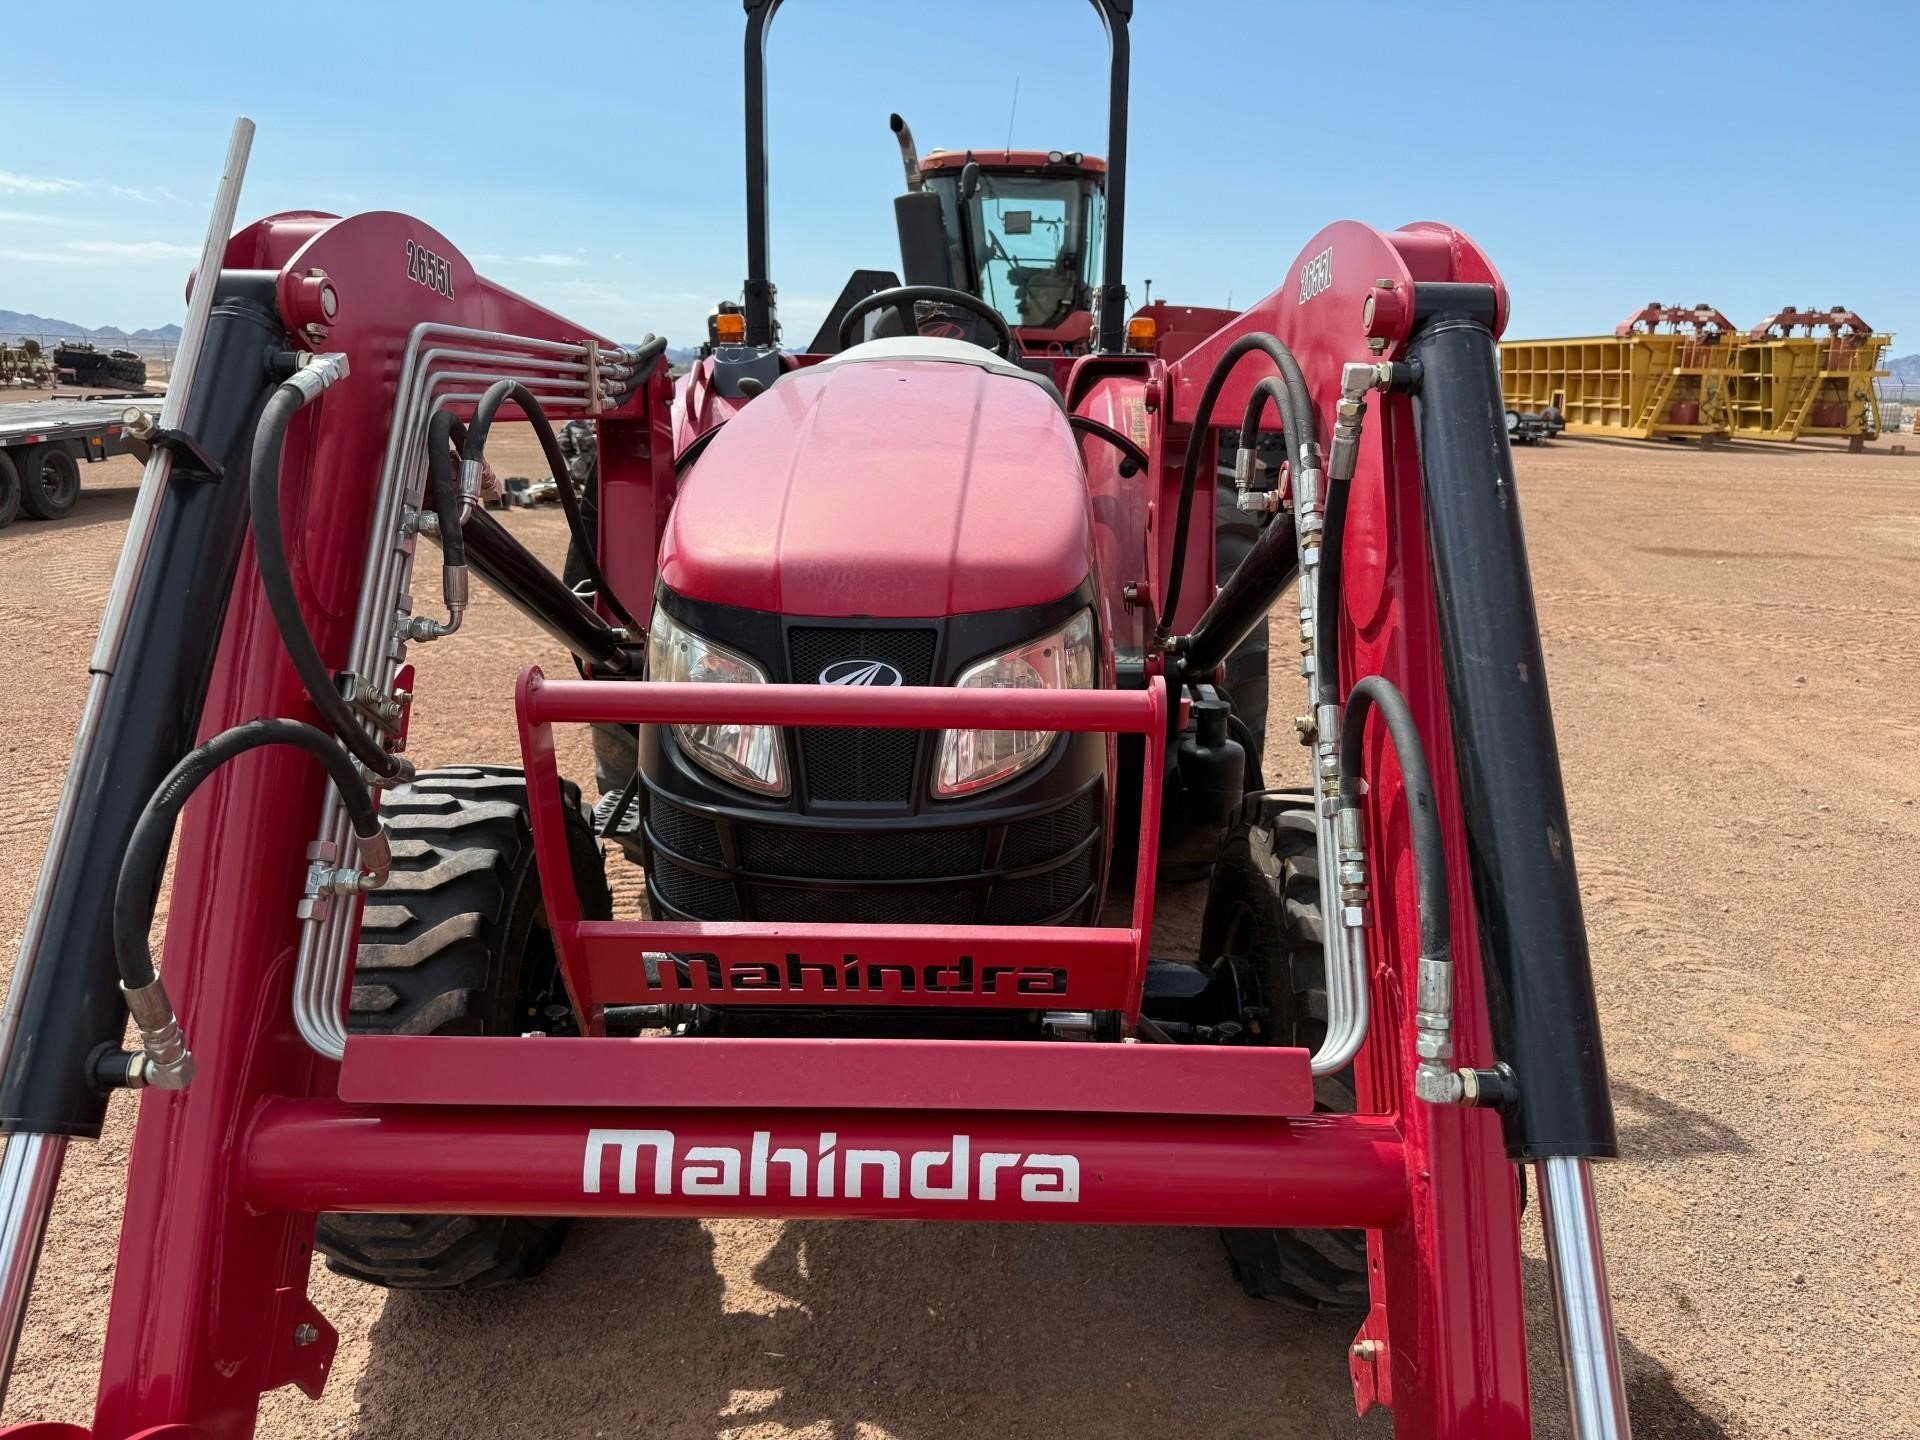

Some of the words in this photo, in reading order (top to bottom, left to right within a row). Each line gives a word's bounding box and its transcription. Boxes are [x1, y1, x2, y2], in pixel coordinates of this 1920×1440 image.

[407, 239, 454, 301] 2655L
[641, 951, 1068, 996] Mahindra
[583, 1128, 1080, 1203] Mahindra
